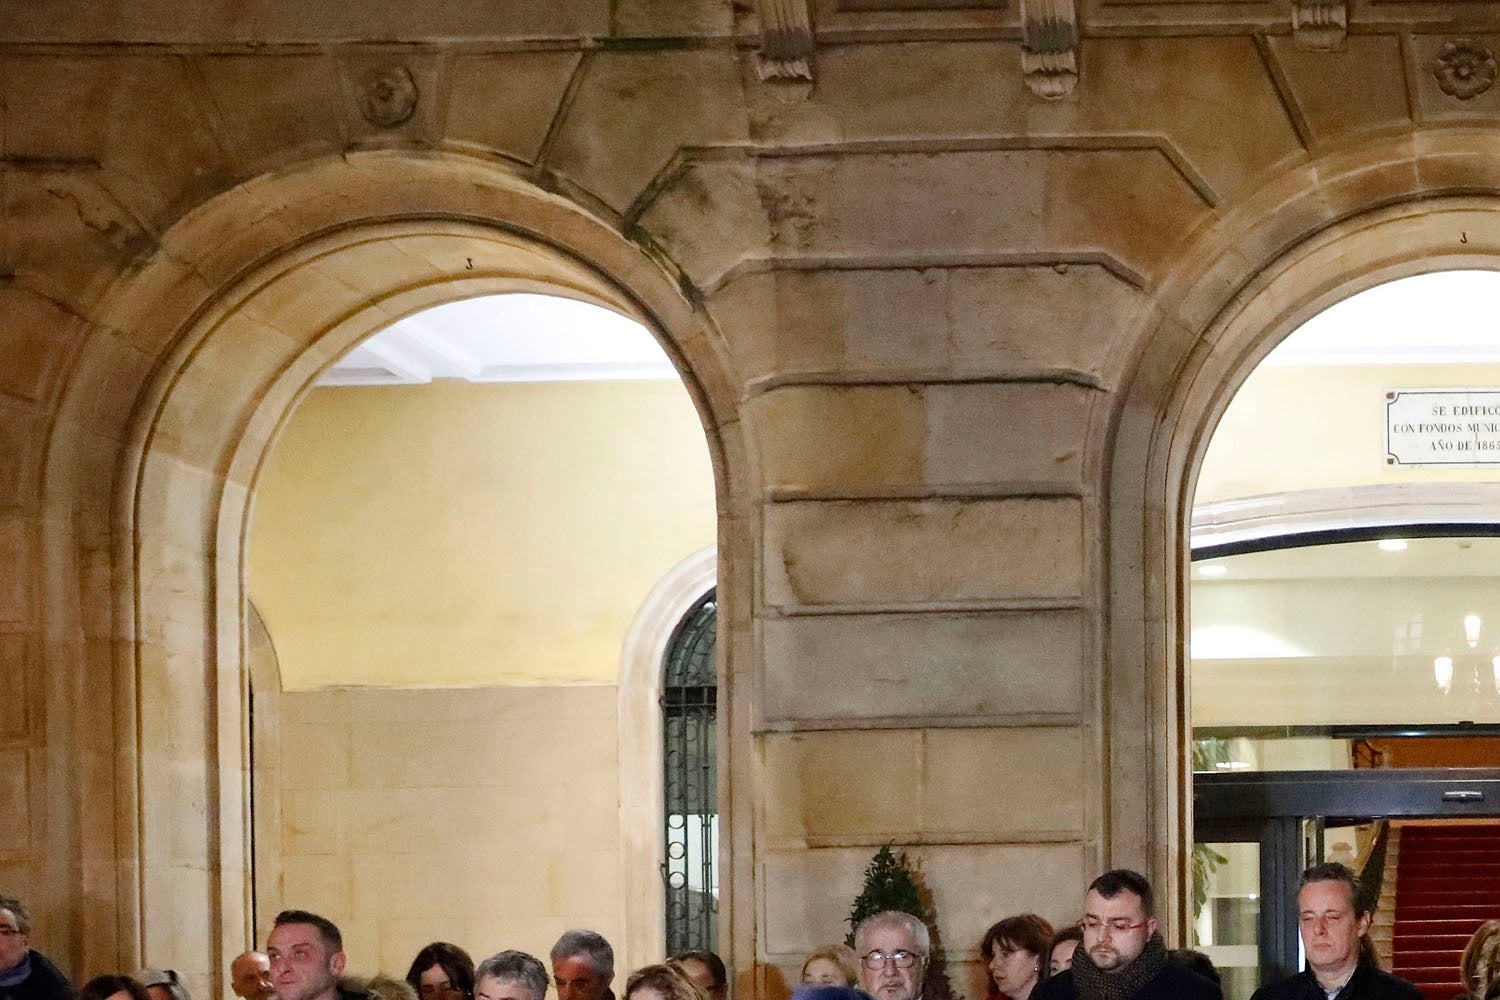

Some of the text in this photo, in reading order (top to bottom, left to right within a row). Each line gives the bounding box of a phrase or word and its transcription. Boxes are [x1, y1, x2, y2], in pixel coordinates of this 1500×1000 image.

[1431, 405, 1447, 416] SE
[1393, 423, 1415, 434] CON
[1419, 423, 1463, 433] FONDOS
[1430, 439, 1453, 451] AÑO
[1457, 441, 1472, 451] DE
